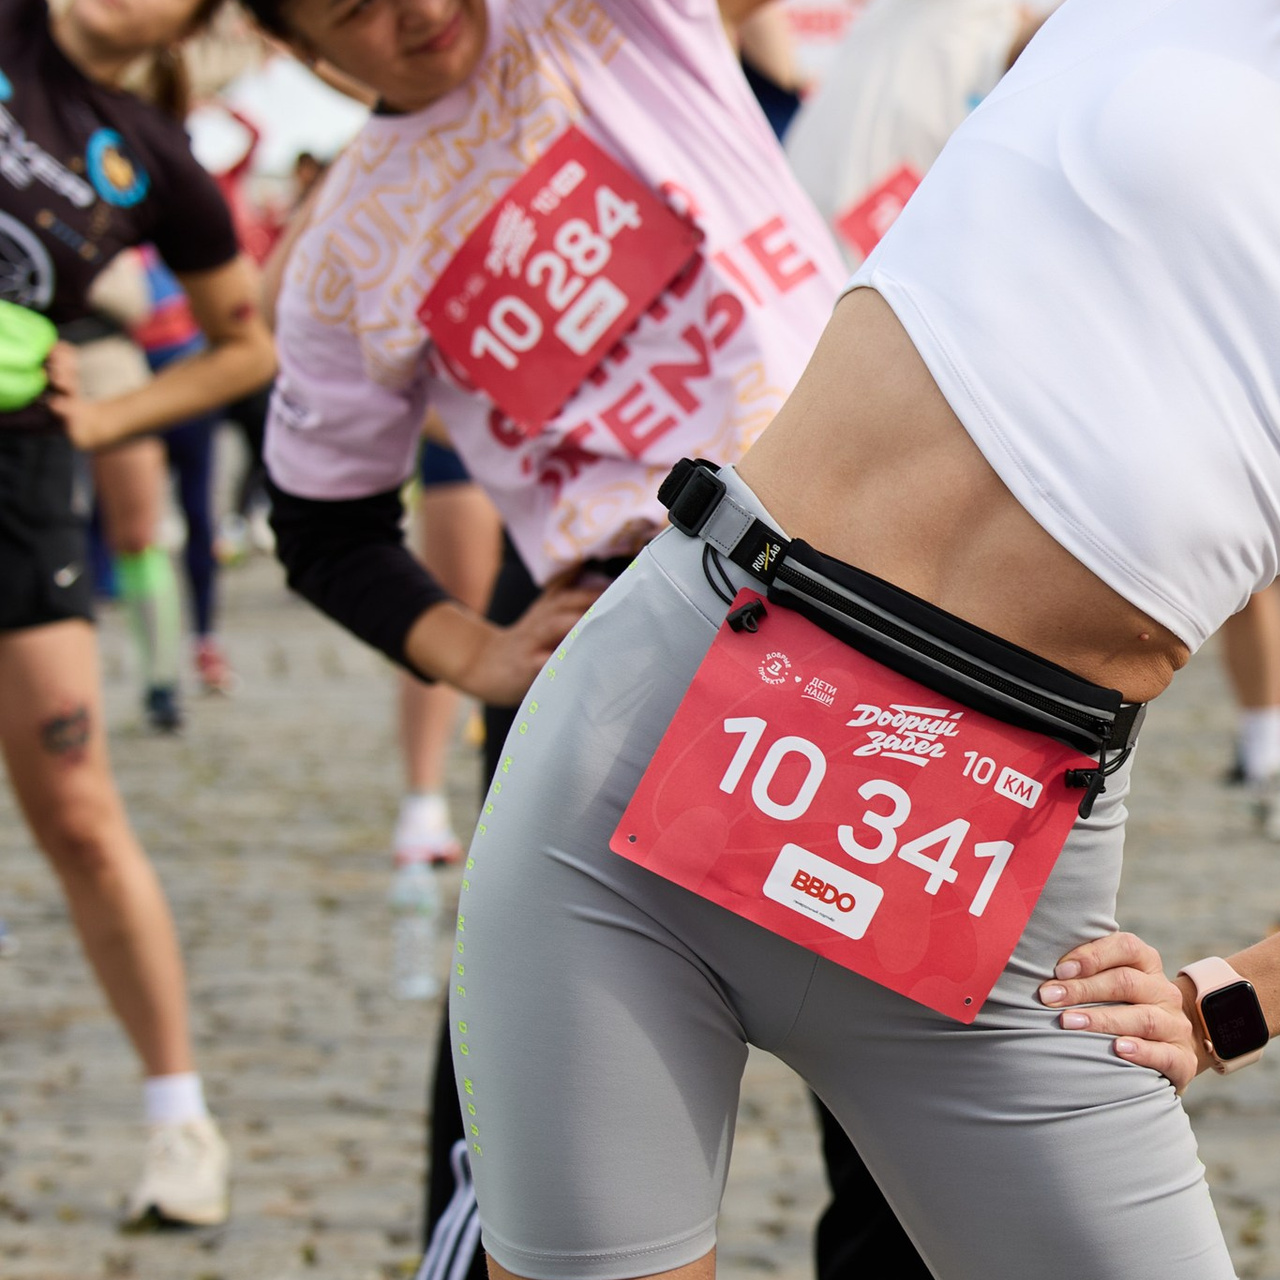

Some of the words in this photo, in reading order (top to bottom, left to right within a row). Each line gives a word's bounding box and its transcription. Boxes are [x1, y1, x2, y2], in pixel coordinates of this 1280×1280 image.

[469, 295, 543, 370] 10
[526, 185, 642, 312] 284
[752, 551, 767, 572] RUN
[768, 543, 781, 562] LAB
[758, 666, 786, 685] ПРОЕКТЫ
[766, 652, 792, 668] ДОБРЫЕ
[803, 684, 835, 706] НАШИ
[809, 677, 837, 696] ДЕТИ
[846, 703, 964, 737] Добрый
[852, 730, 947, 759] забег
[962, 750, 996, 785] 10
[478, 755, 513, 835] MORE
[719, 716, 827, 821] 10
[837, 779, 1014, 917] 341
[791, 868, 856, 913] BBDO
[456, 914, 467, 998] MORE
[458, 1020, 469, 1056] DO
[463, 1076, 483, 1157] MORE
